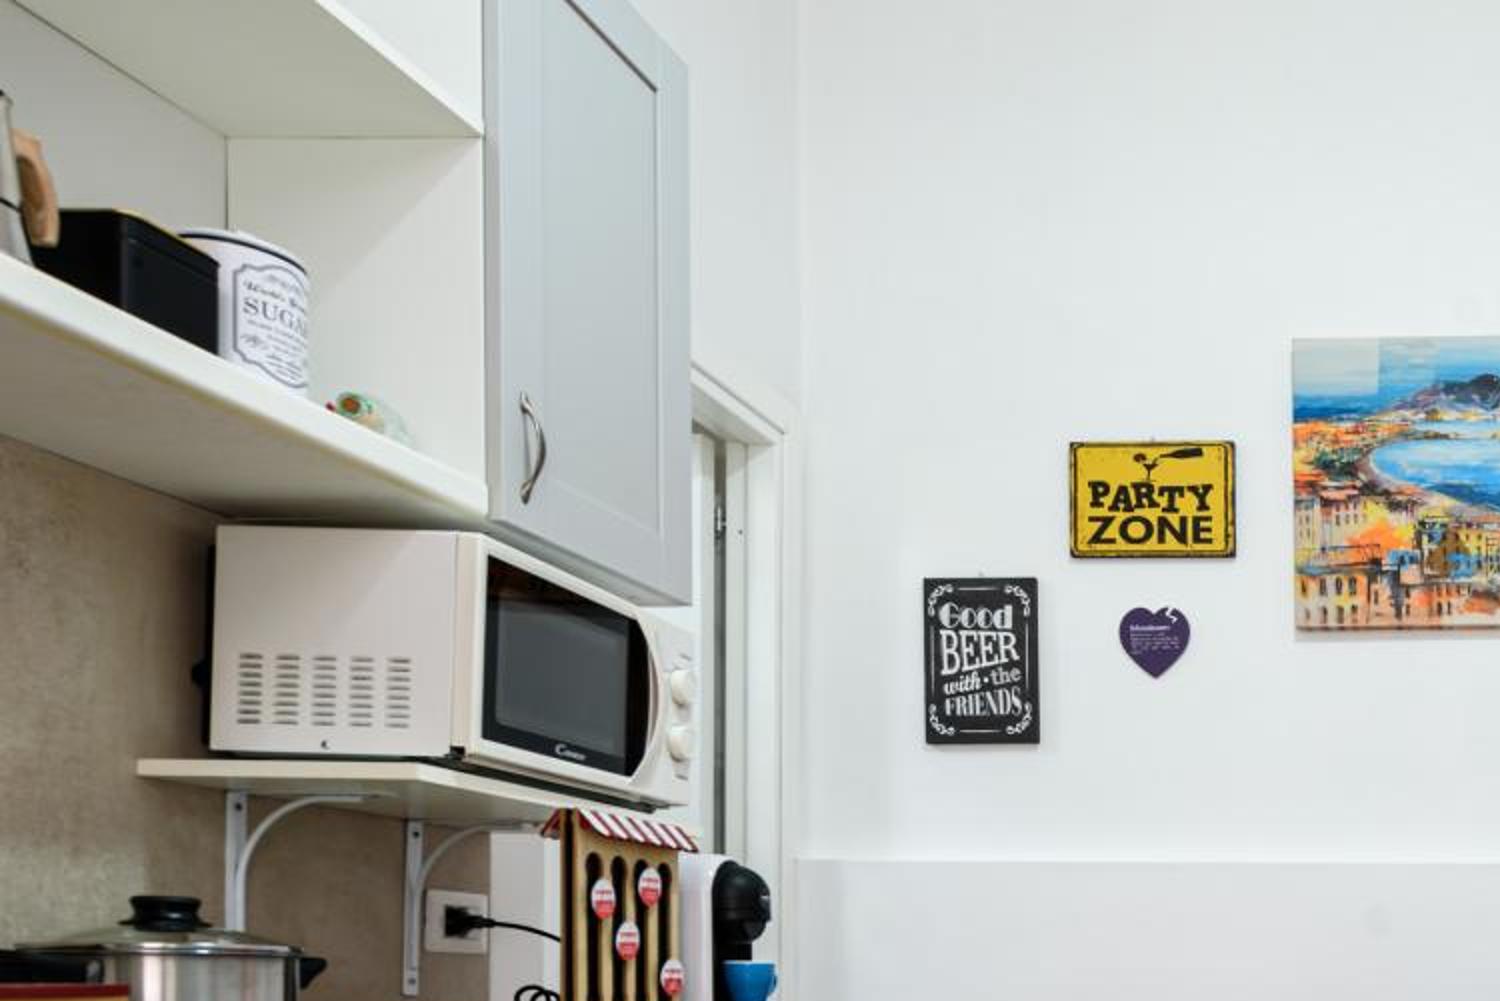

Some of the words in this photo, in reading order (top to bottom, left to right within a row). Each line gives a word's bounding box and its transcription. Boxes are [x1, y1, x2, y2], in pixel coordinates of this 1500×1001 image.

[242, 297, 305, 336] SUGA
[1087, 480, 1214, 513] PARTY
[1087, 515, 1213, 545] ZONE
[939, 601, 1013, 629] Good
[939, 629, 1020, 676] BEER
[943, 671, 982, 696] with
[989, 666, 1022, 686] the
[944, 685, 1023, 717] FRIENDS
